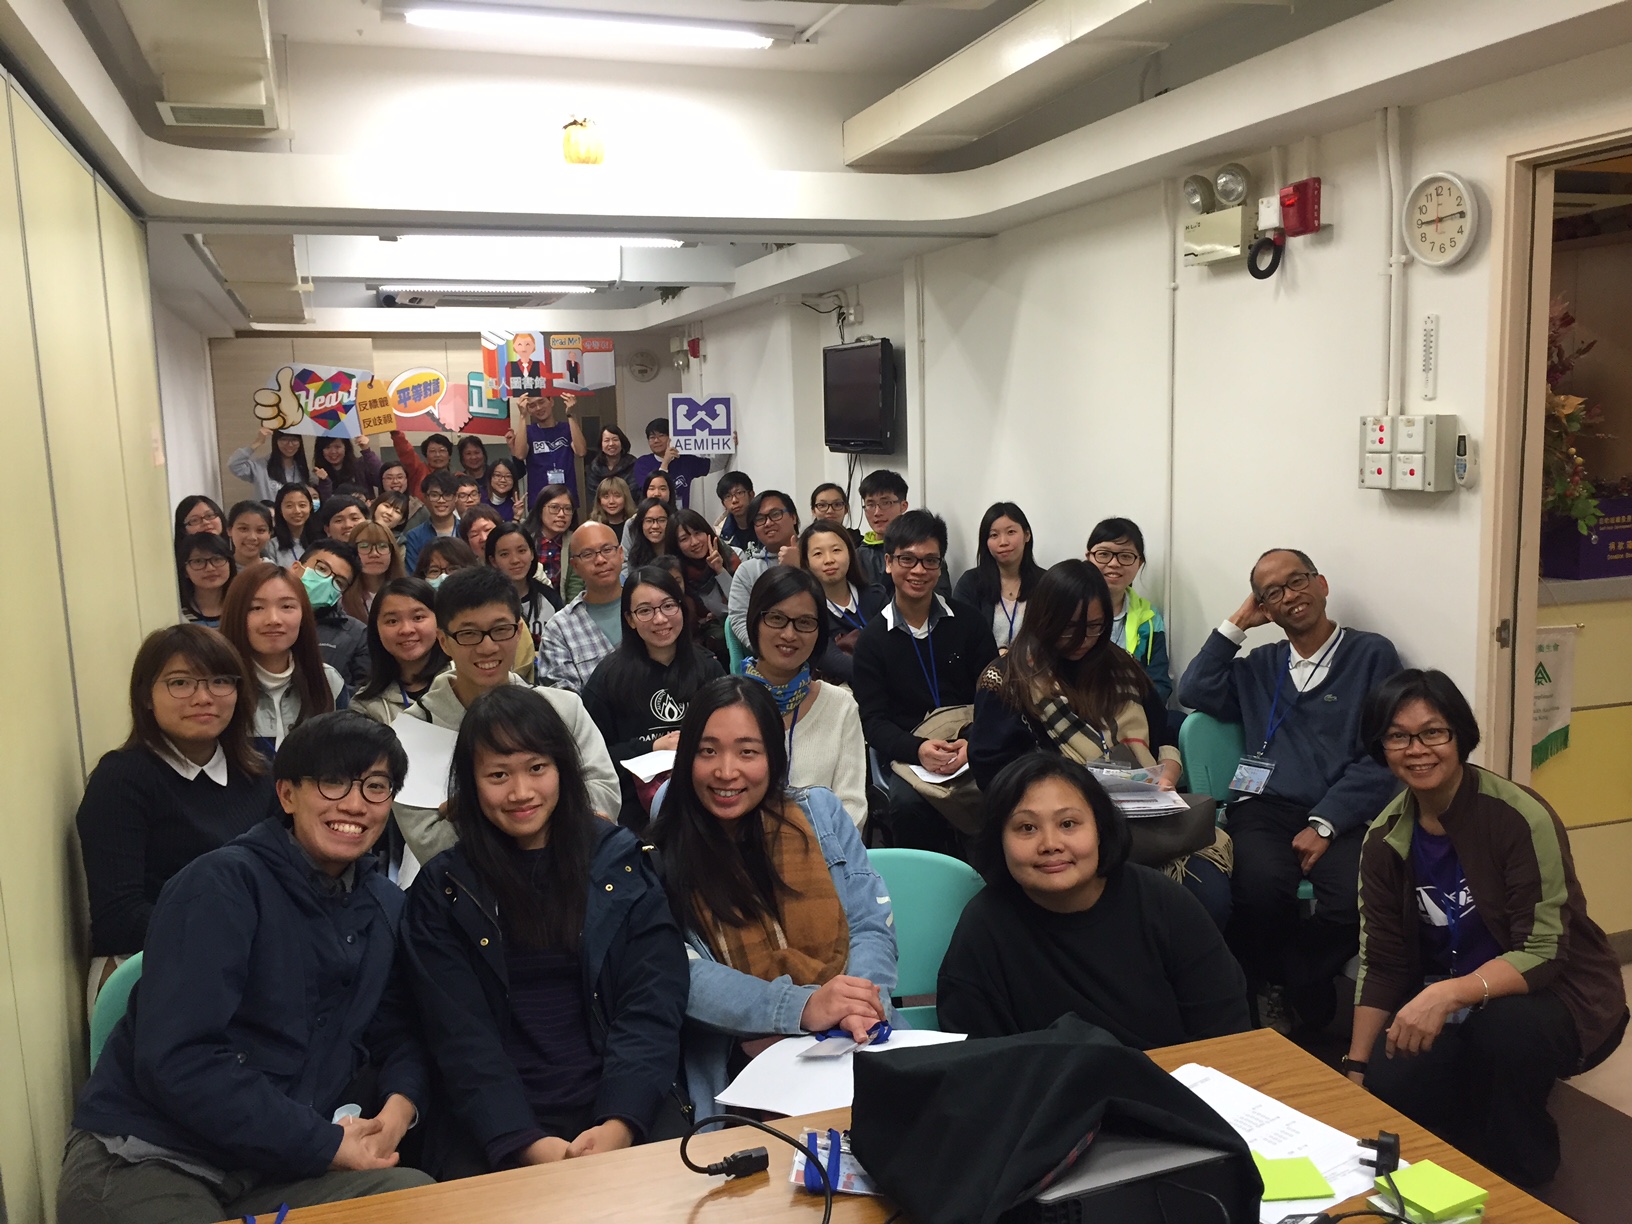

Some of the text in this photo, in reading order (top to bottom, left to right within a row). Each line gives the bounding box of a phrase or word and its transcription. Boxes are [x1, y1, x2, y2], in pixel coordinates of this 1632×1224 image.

[1434, 185, 1444, 197] 12
[1447, 187, 1452, 197] 1
[1425, 193, 1433, 203] 11
[1455, 196, 1463, 207] 2
[1418, 204, 1428, 216] 10
[1416, 218, 1423, 229] 9
[1457, 225, 1464, 235] 4
[1420, 232, 1427, 243] 8
[1449, 237, 1457, 248] 5
[1430, 241, 1436, 252] 7
[1439, 243, 1446, 254] 6
[551, 337, 567, 346] Read
[296, 379, 357, 412] Heart
[396, 377, 440, 409] 平等對話
[362, 413, 394, 429] 反歧視
[674, 438, 731, 451] AEMIHK
